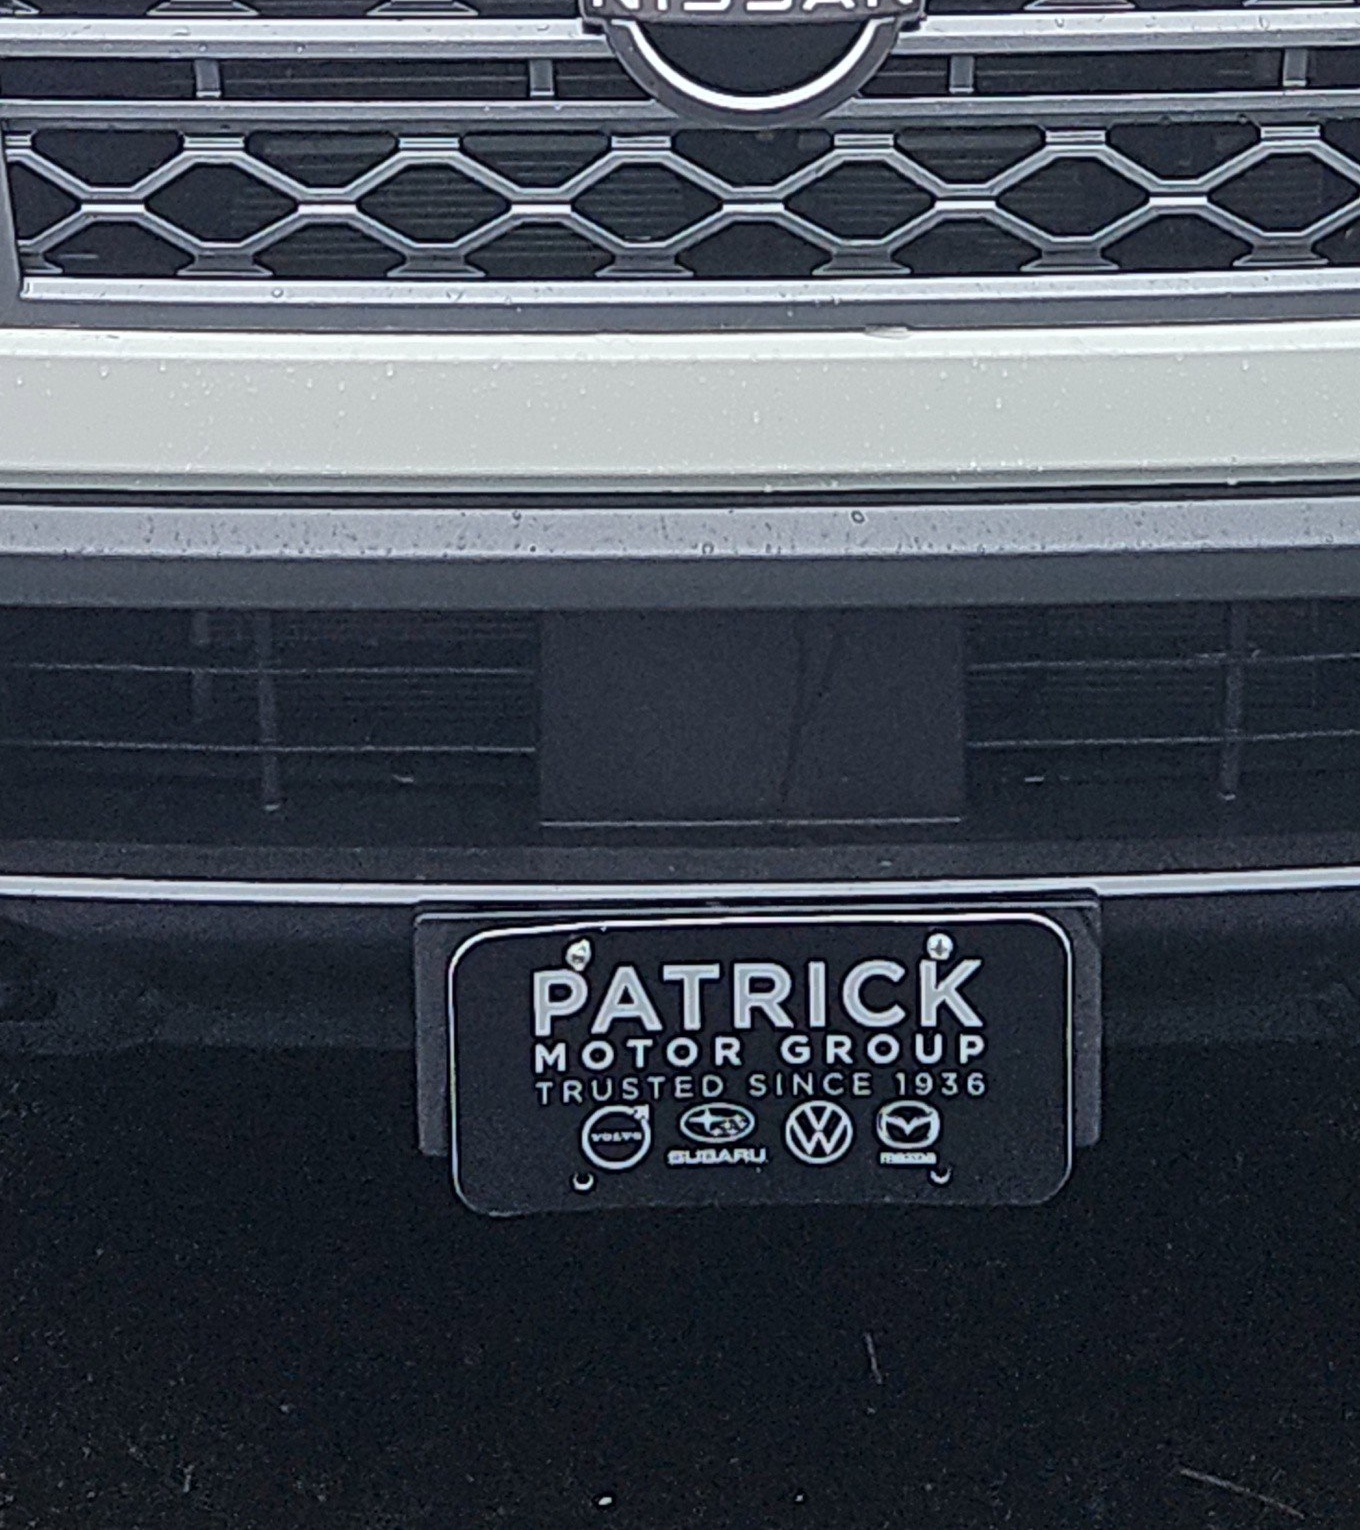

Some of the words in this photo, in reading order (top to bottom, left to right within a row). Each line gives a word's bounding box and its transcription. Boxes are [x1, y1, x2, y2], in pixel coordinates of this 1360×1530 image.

[534, 959, 983, 1036] PATRICK
[534, 1036, 742, 1073] MOTOR
[780, 1033, 985, 1065] GROUP
[535, 1074, 724, 1105] TRUSTED
[749, 1072, 872, 1096] SINCE
[895, 1072, 985, 1096] 1936
[591, 1131, 642, 1142] VOLVO
[667, 1148, 767, 1165] SUBARU
